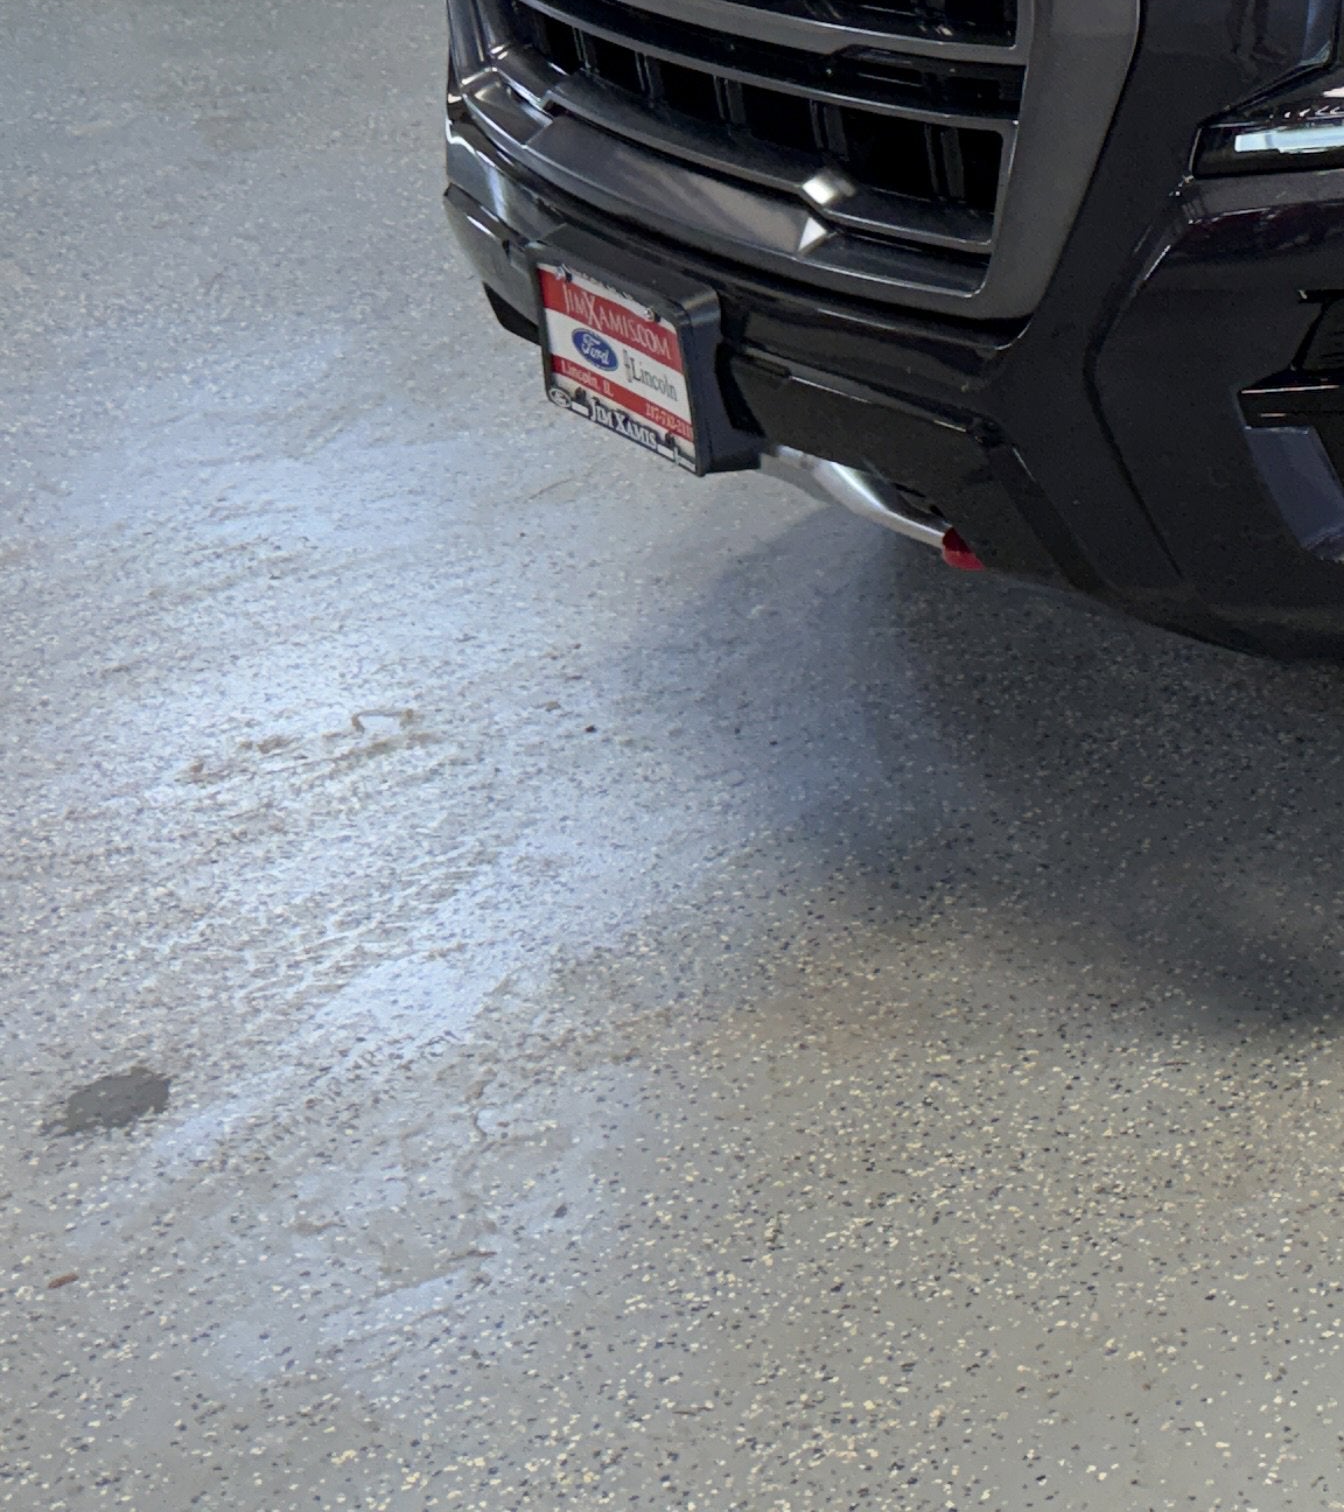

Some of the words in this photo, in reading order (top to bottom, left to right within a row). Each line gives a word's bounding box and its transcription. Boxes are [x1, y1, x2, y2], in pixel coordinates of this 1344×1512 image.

[631, 357, 679, 402] Lincoln
[589, 397, 613, 429] JIM
[613, 409, 657, 450] XAMIS
